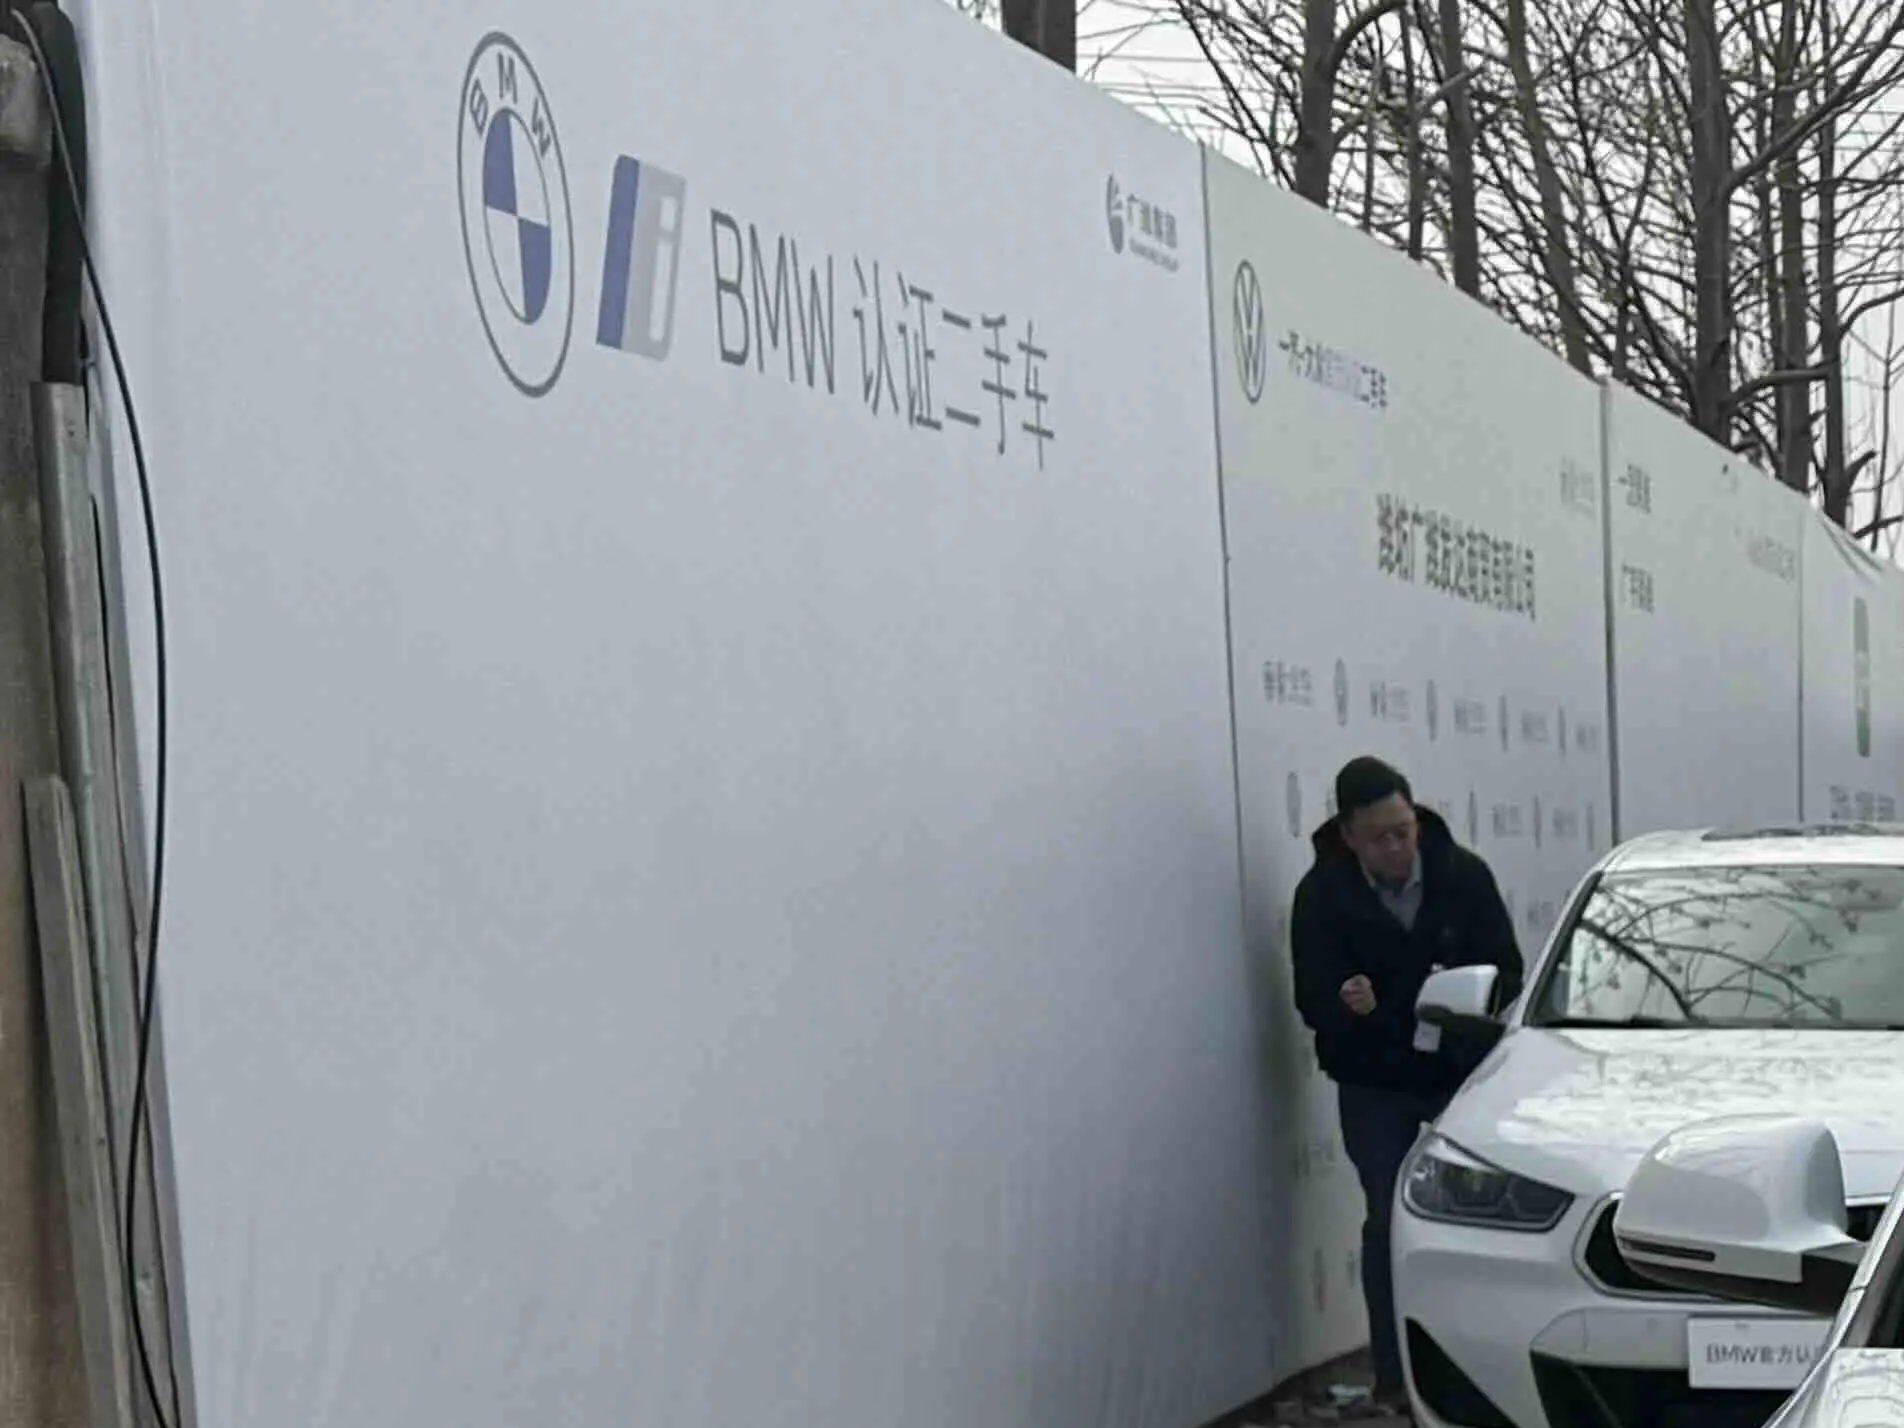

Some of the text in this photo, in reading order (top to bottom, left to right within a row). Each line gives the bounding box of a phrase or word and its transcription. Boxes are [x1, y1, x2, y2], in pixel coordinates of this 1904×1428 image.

[469, 51, 552, 157] BMW
[710, 207, 1055, 472] BMW 认证二手车
